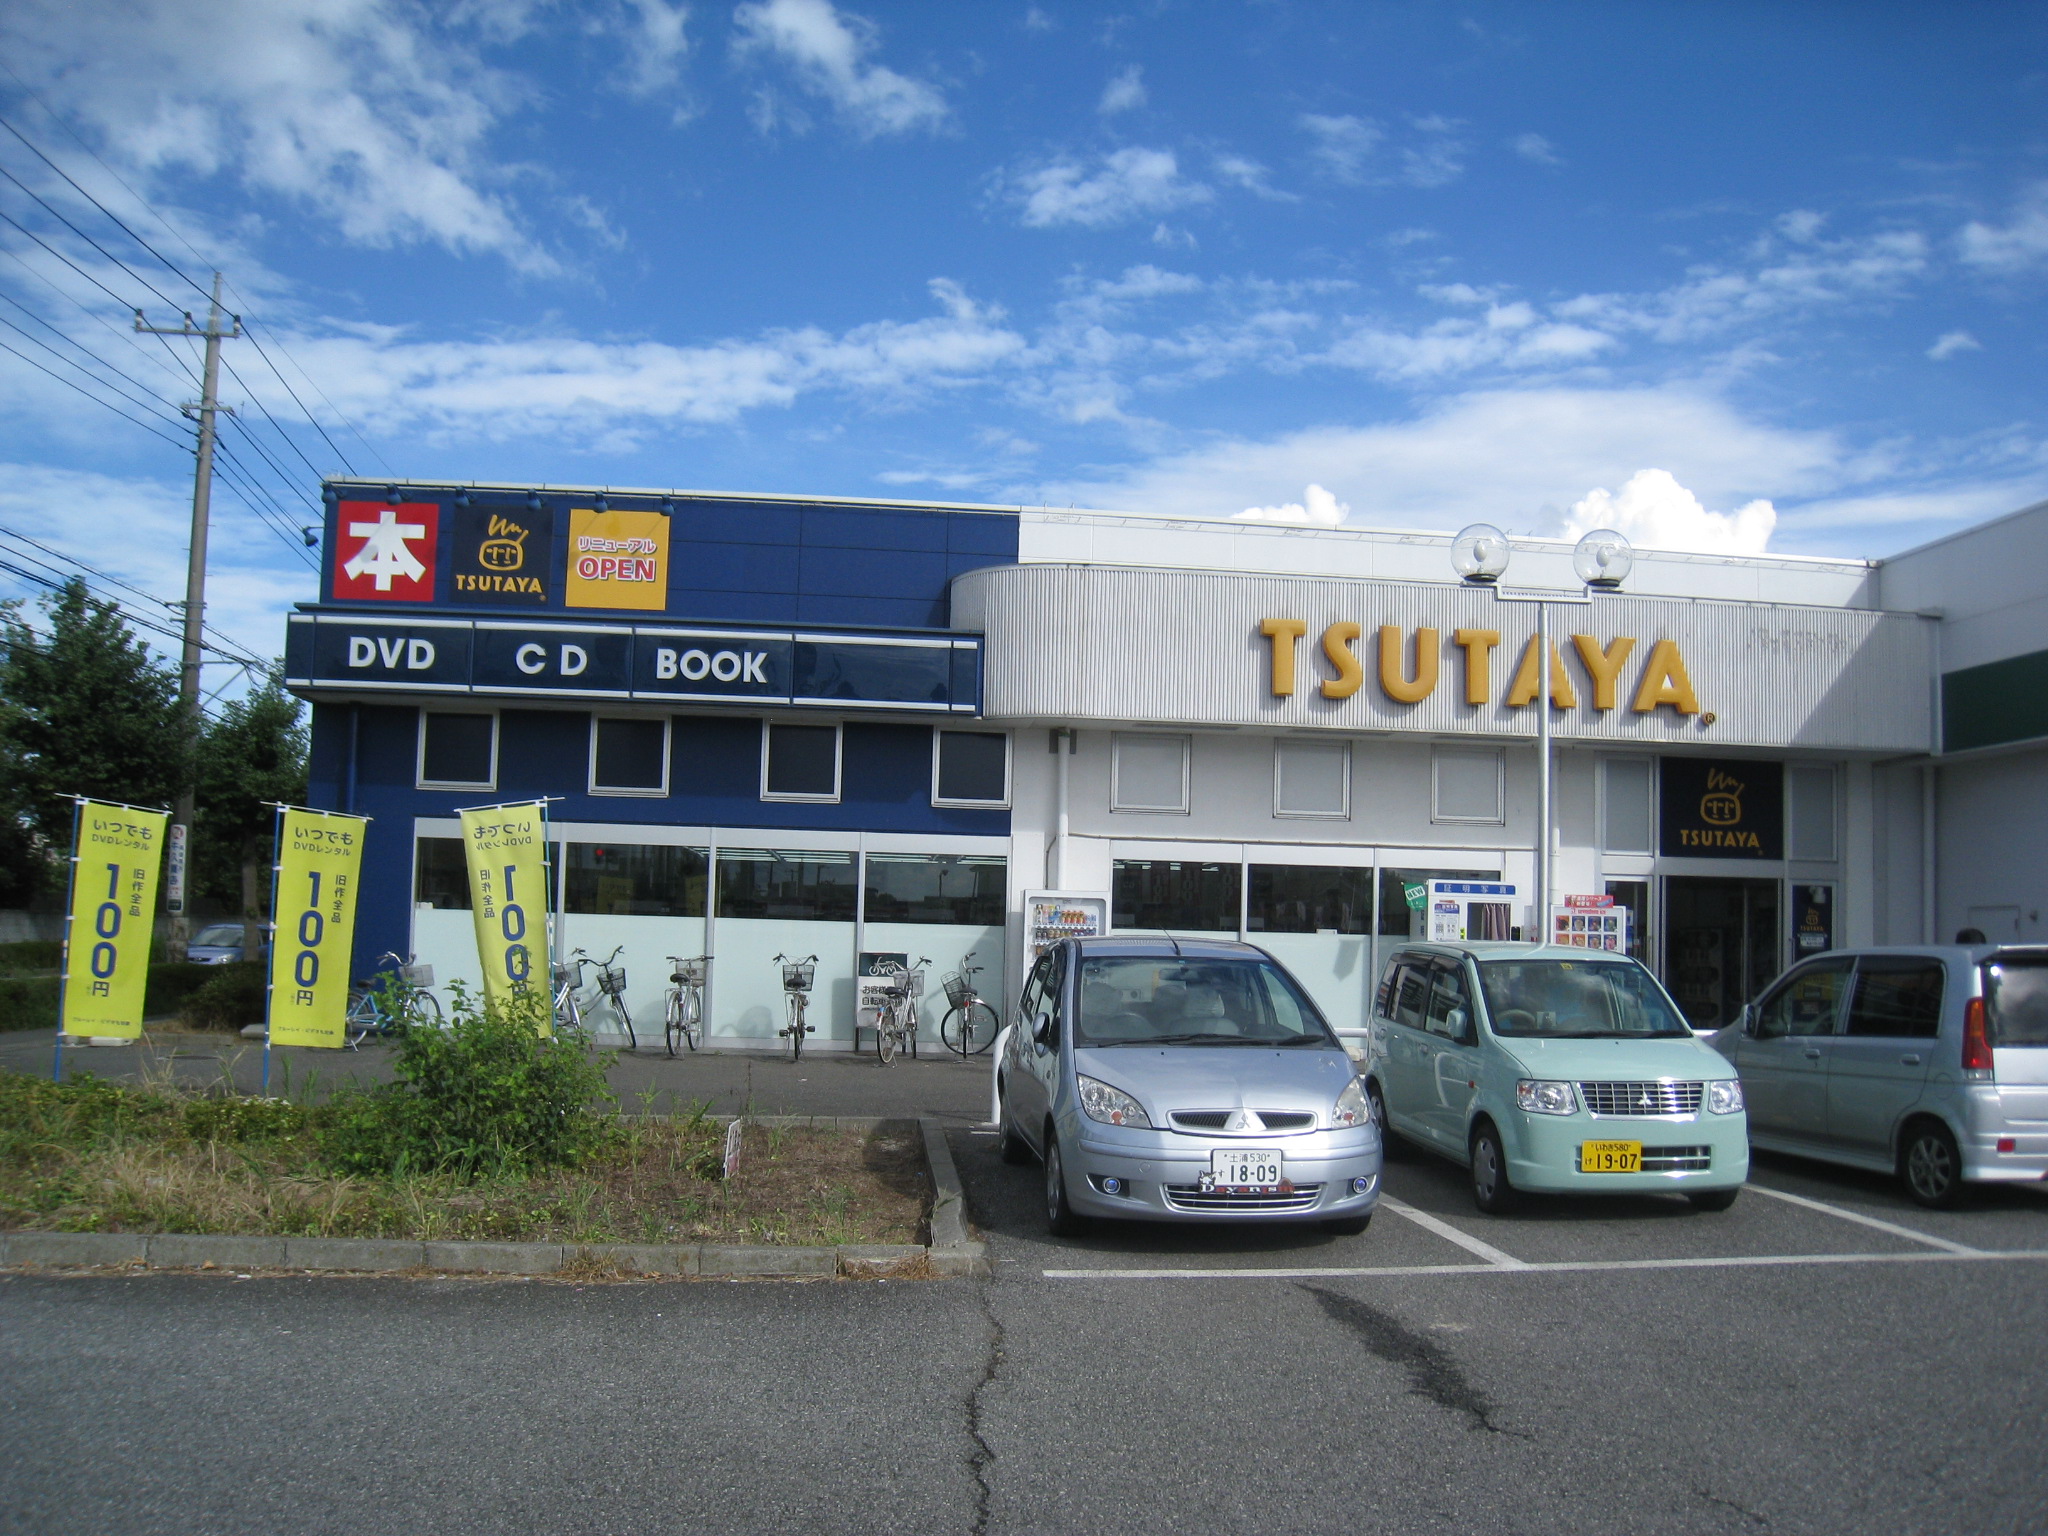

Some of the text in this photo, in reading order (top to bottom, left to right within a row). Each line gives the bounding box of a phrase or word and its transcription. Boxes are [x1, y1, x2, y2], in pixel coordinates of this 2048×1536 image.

[343, 511, 426, 591] 本
[578, 536, 657, 554] リニューアル
[577, 556, 655, 581] OPEN
[456, 574, 542, 594] TSUTAYA
[349, 636, 435, 670] DVD
[657, 648, 769, 684] BOOK
[1260, 618, 1699, 714] TSUTAYA
[93, 819, 152, 840] いつでも
[295, 826, 353, 845] いつでも
[1680, 829, 1760, 848] TSUTAYA
[92, 833, 150, 851] DVDレンタル
[294, 841, 351, 856] DVDレンタル
[129, 868, 145, 917] 旧作全品
[331, 874, 347, 924] 旧作全品
[1406, 887, 1424, 898] NEW
[1597, 1153, 1638, 1169] 19-07
[1230, 1164, 1277, 1182] 18-09
